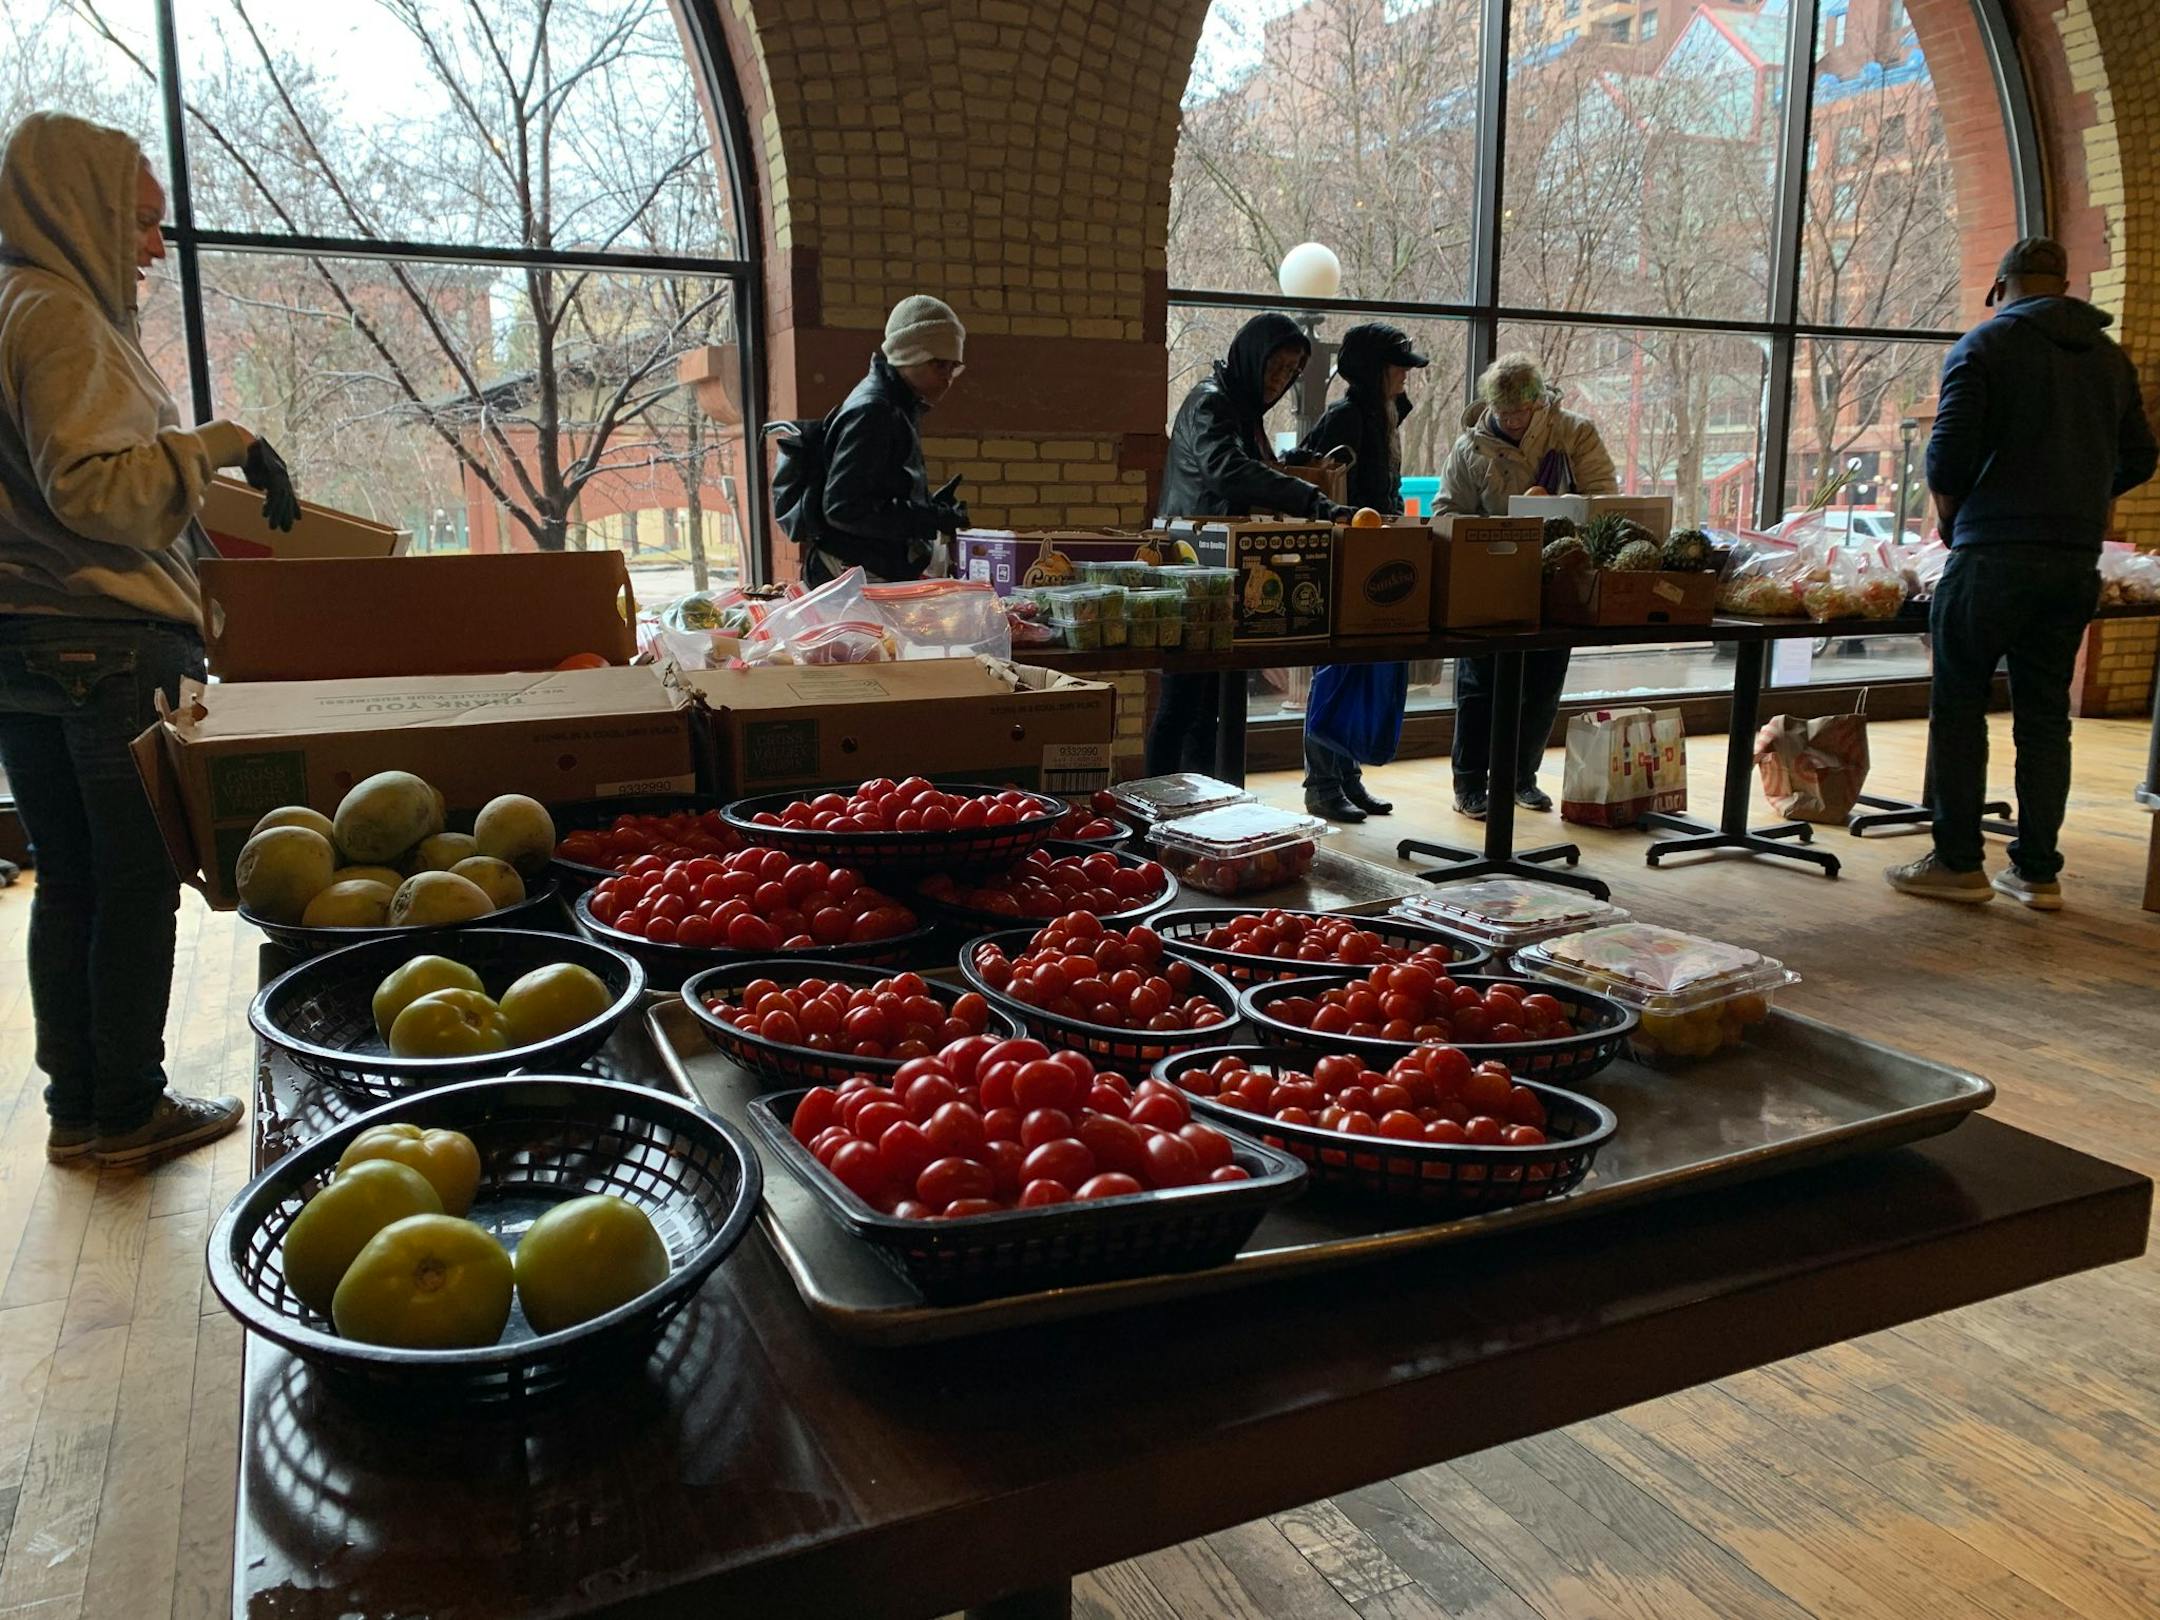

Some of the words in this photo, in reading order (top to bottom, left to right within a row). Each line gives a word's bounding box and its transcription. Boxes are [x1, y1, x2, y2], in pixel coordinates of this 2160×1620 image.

[365, 701, 422, 713] YOU
[436, 697, 527, 711] THANK
[618, 780, 672, 796] 9332990
